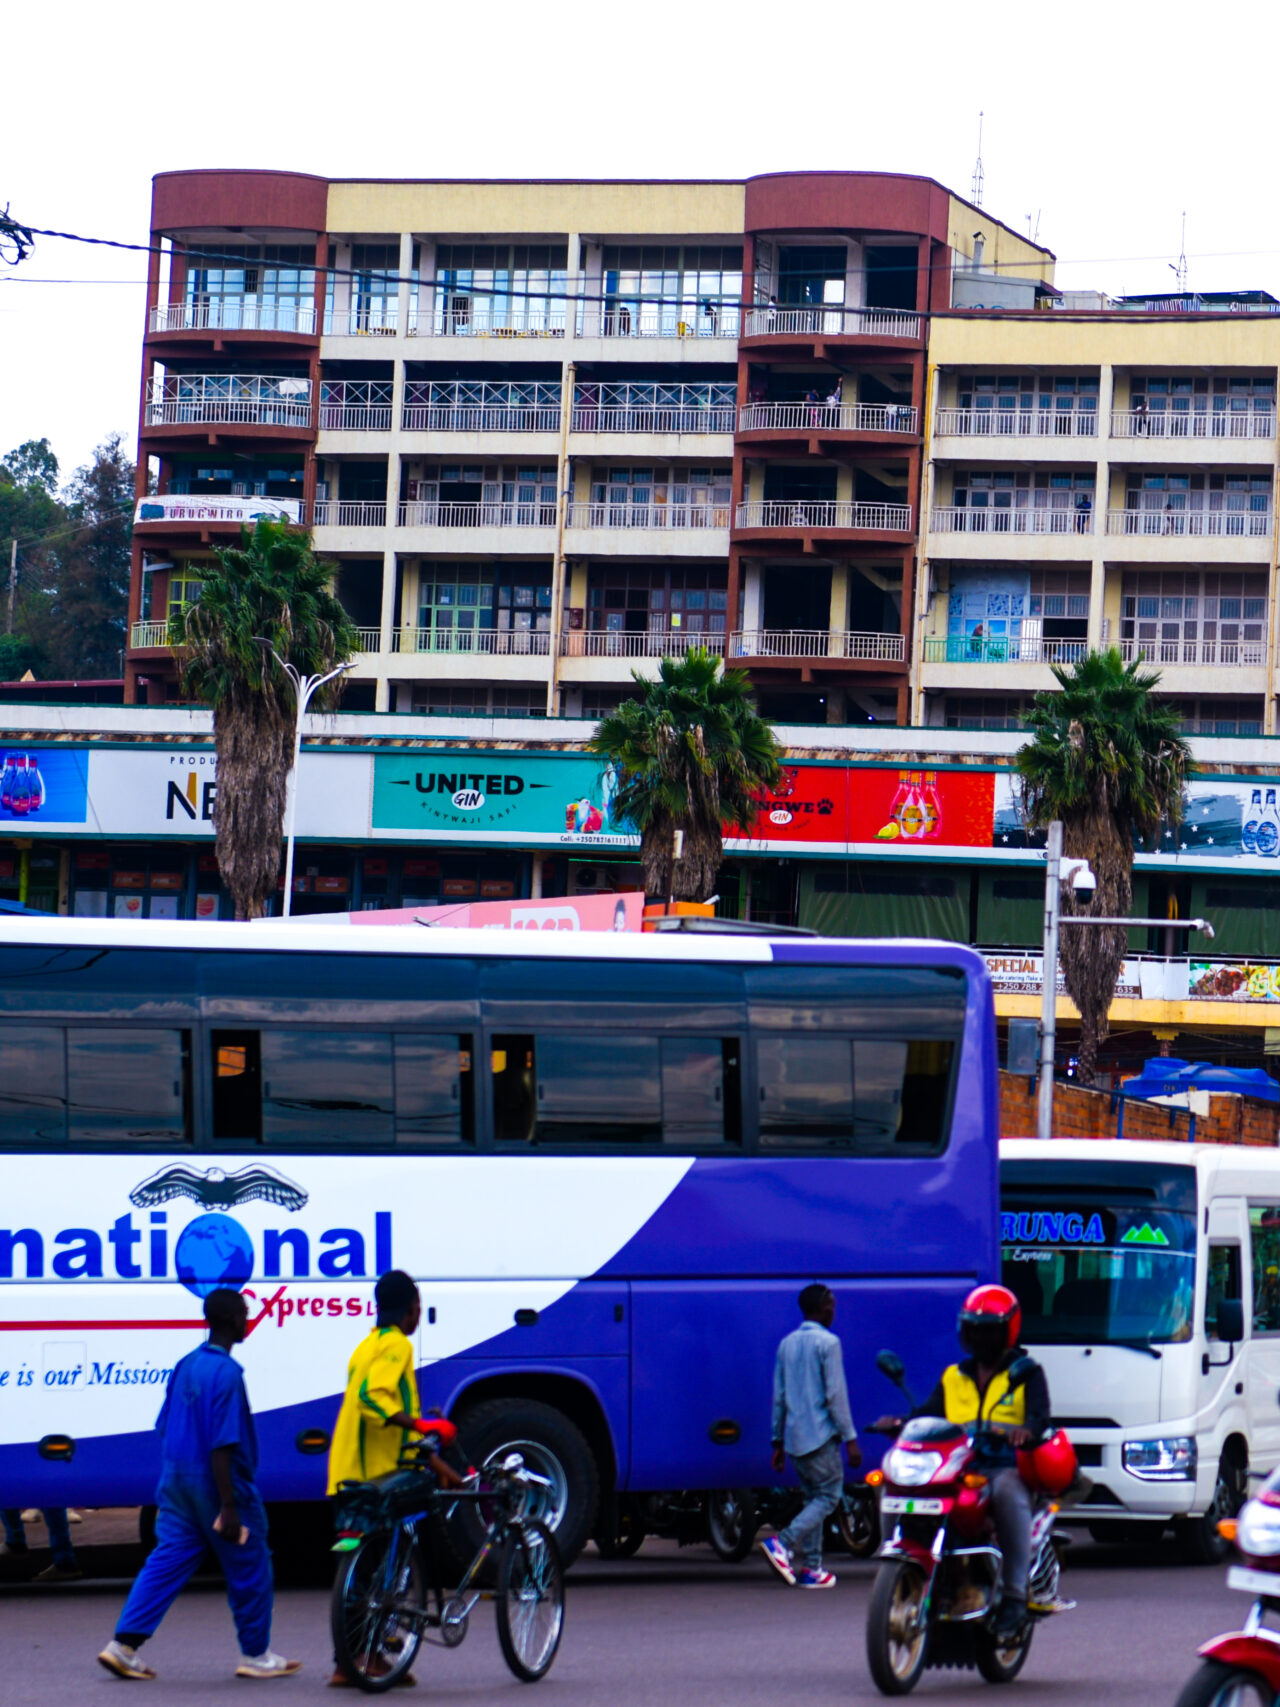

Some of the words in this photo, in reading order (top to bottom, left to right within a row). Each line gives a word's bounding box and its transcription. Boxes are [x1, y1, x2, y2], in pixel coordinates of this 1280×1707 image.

[416, 772, 524, 795] UNITED
[454, 792, 481, 806] GIN
[759, 801, 814, 813] NGWE
[771, 812, 789, 822] GIN
[987, 959, 1038, 973] SPECIAL
[17, 1363, 35, 1387] is
[45, 1368, 82, 1386] our
[88, 1361, 174, 1386] Mission
